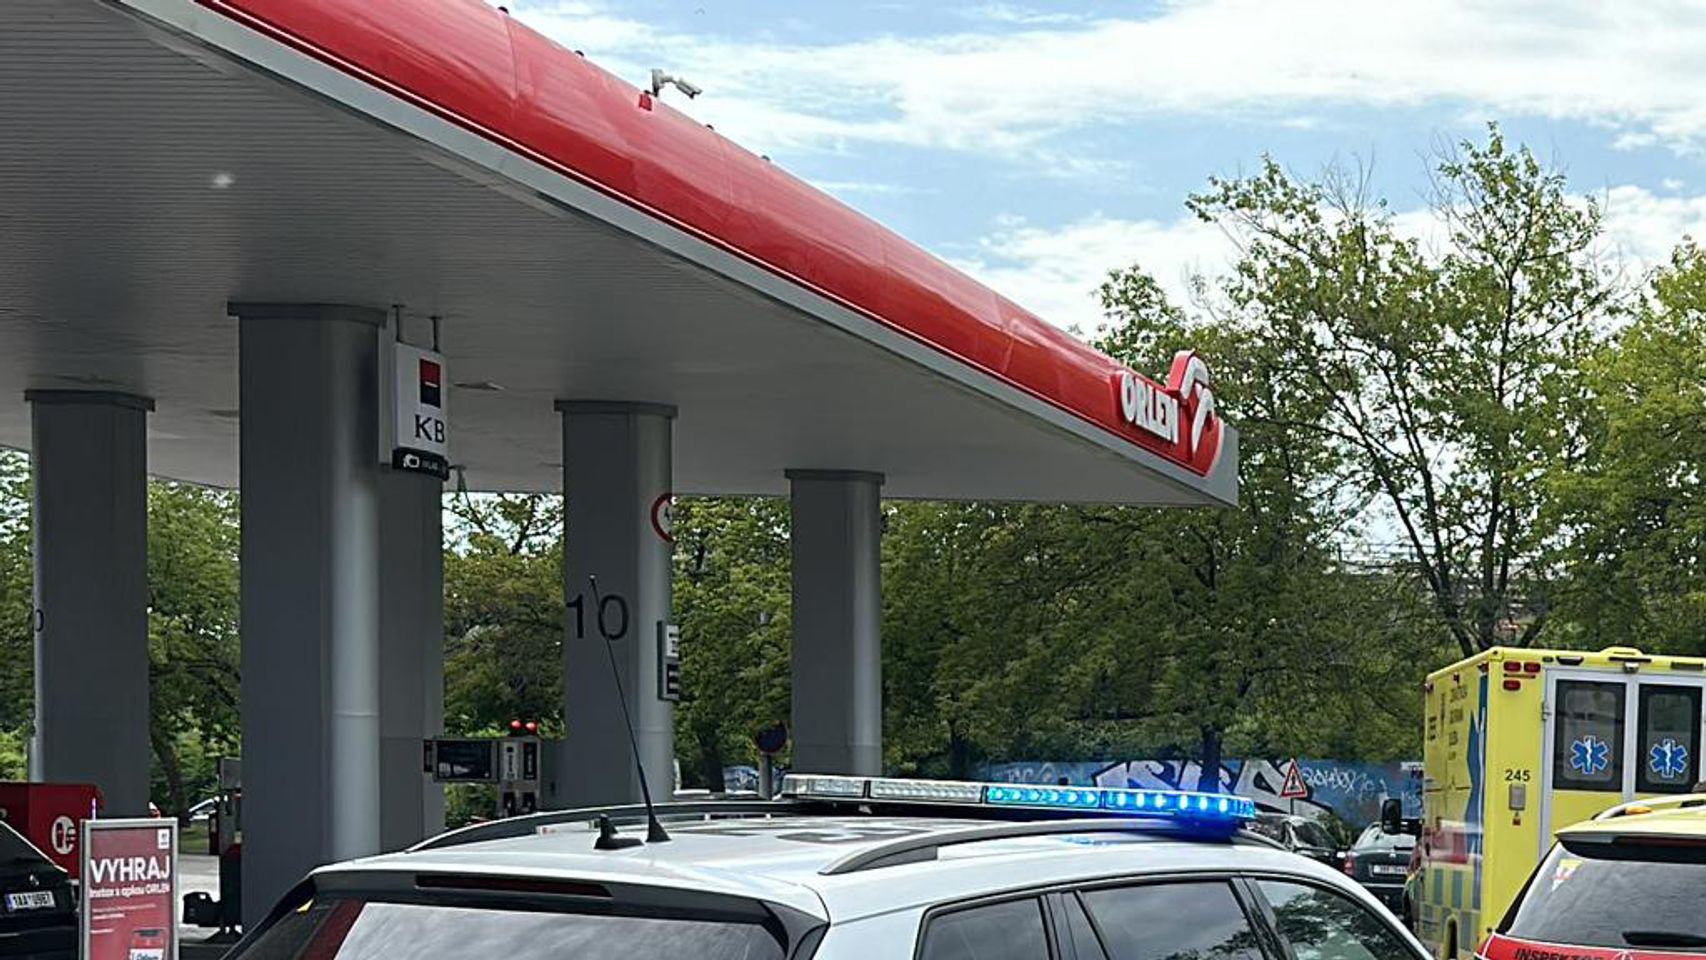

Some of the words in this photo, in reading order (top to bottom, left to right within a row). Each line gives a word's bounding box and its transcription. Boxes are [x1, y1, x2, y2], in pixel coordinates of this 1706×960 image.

[1121, 370, 1178, 445] ORLEN
[415, 414, 445, 443] KB
[566, 593, 629, 640] 10
[1505, 769, 1531, 781] 245
[90, 855, 170, 883] VYHRAJ
